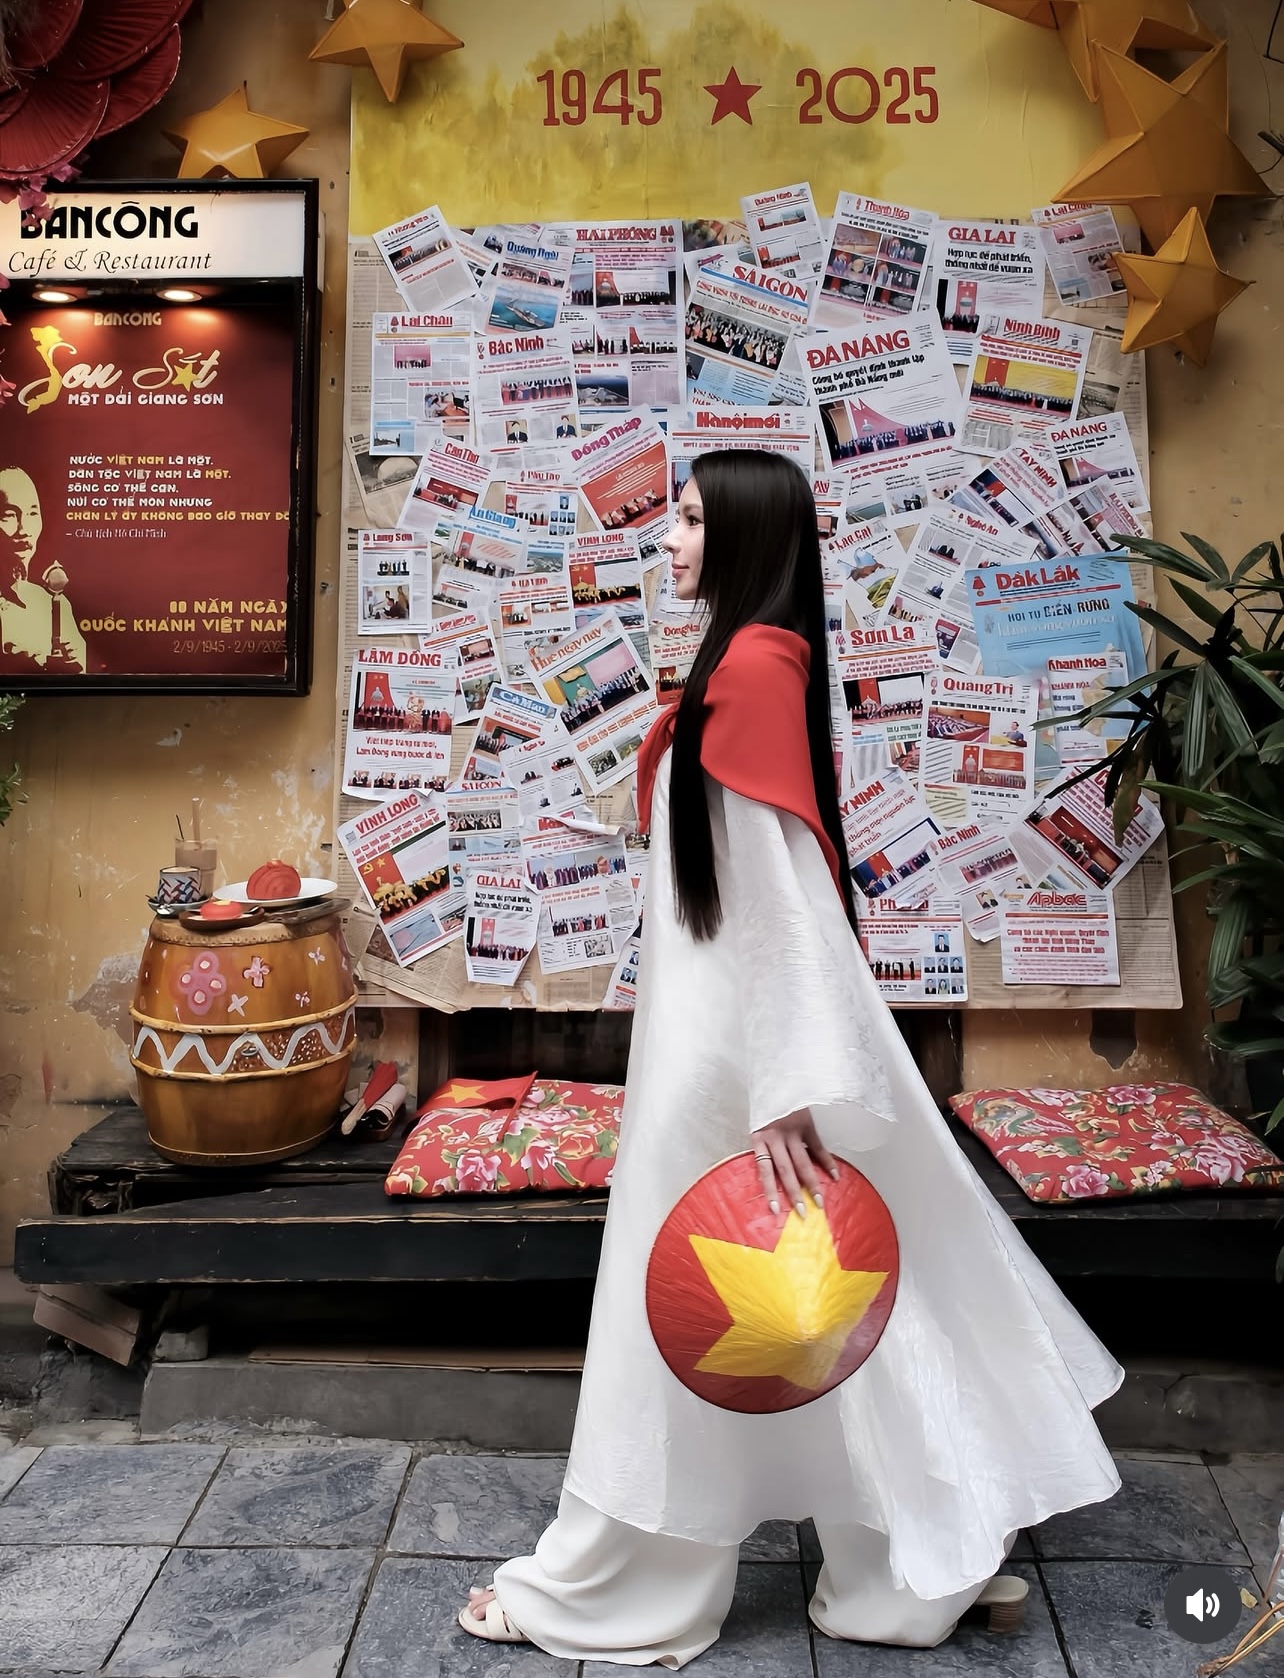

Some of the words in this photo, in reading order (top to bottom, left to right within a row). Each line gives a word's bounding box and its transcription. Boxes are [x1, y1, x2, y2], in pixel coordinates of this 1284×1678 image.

[536, 68, 662, 126] 1945
[796, 66, 939, 124] 2025
[20, 200, 200, 239] BANCÔNG
[948, 226, 982, 243] GIA
[984, 229, 1017, 245] LAI
[8, 250, 56, 277] Café
[94, 251, 213, 271] Restaurant
[514, 335, 544, 352] Ninh
[18, 341, 123, 409] Son
[68, 391, 100, 406] MỘT
[137, 455, 165, 465] NAM
[155, 470, 182, 479] NAM
[187, 511, 212, 521] BAO
[240, 511, 271, 521] THAY
[193, 597, 234, 614] NĂM
[80, 613, 127, 632] QUỐC
[133, 617, 196, 632] KHÁNH
[202, 616, 245, 633] VIỆT
[250, 618, 287, 632] NAM
[890, 625, 915, 641] La
[173, 640, 225, 653] 2/9/1945
[850, 780, 886, 811] NINH
[386, 793, 419, 818] LONG
